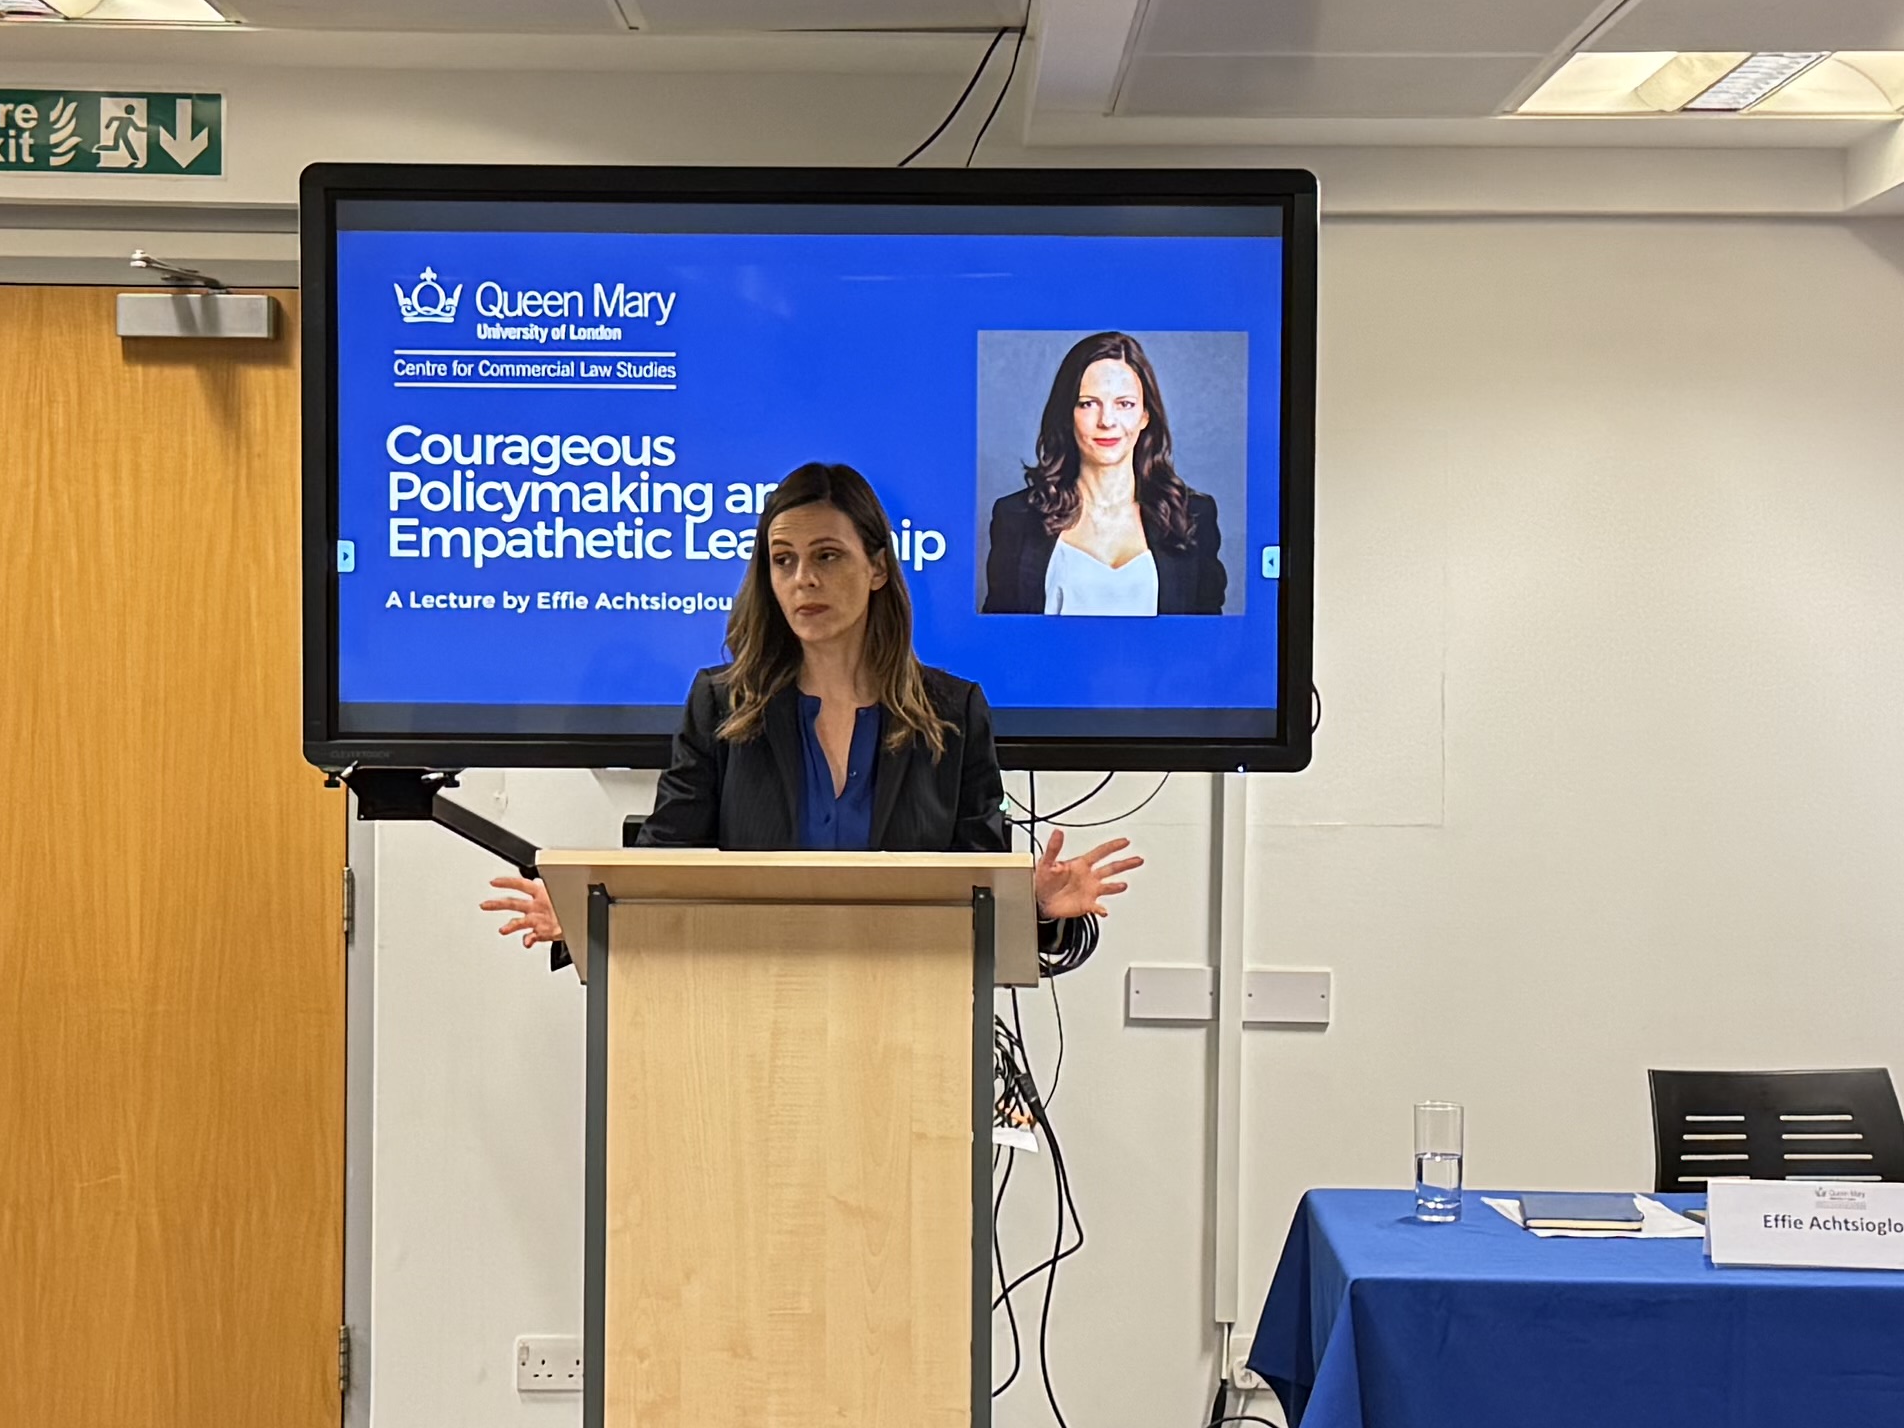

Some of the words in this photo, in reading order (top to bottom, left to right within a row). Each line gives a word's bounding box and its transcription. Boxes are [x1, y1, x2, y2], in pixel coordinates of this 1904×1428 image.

[475, 281, 584, 319] Queen
[593, 283, 676, 326] Mary
[477, 323, 547, 343] University
[551, 324, 566, 340] of
[569, 324, 622, 341] London
[394, 359, 447, 377] Centre
[452, 359, 474, 377] for
[478, 359, 575, 378] Commercial
[580, 361, 612, 378] Law
[616, 360, 676, 379] Studies
[386, 424, 676, 475] Courageous
[388, 470, 714, 524] Policymaking
[725, 482, 779, 514] an
[388, 518, 672, 568] Empathetic
[685, 517, 947, 571] Leaip
[385, 591, 403, 610] A
[409, 591, 495, 611] Lecture
[503, 590, 530, 614] by
[536, 590, 588, 610] Effie
[595, 590, 733, 614] Achtsioglou
[1763, 1214, 1803, 1229] Effie
